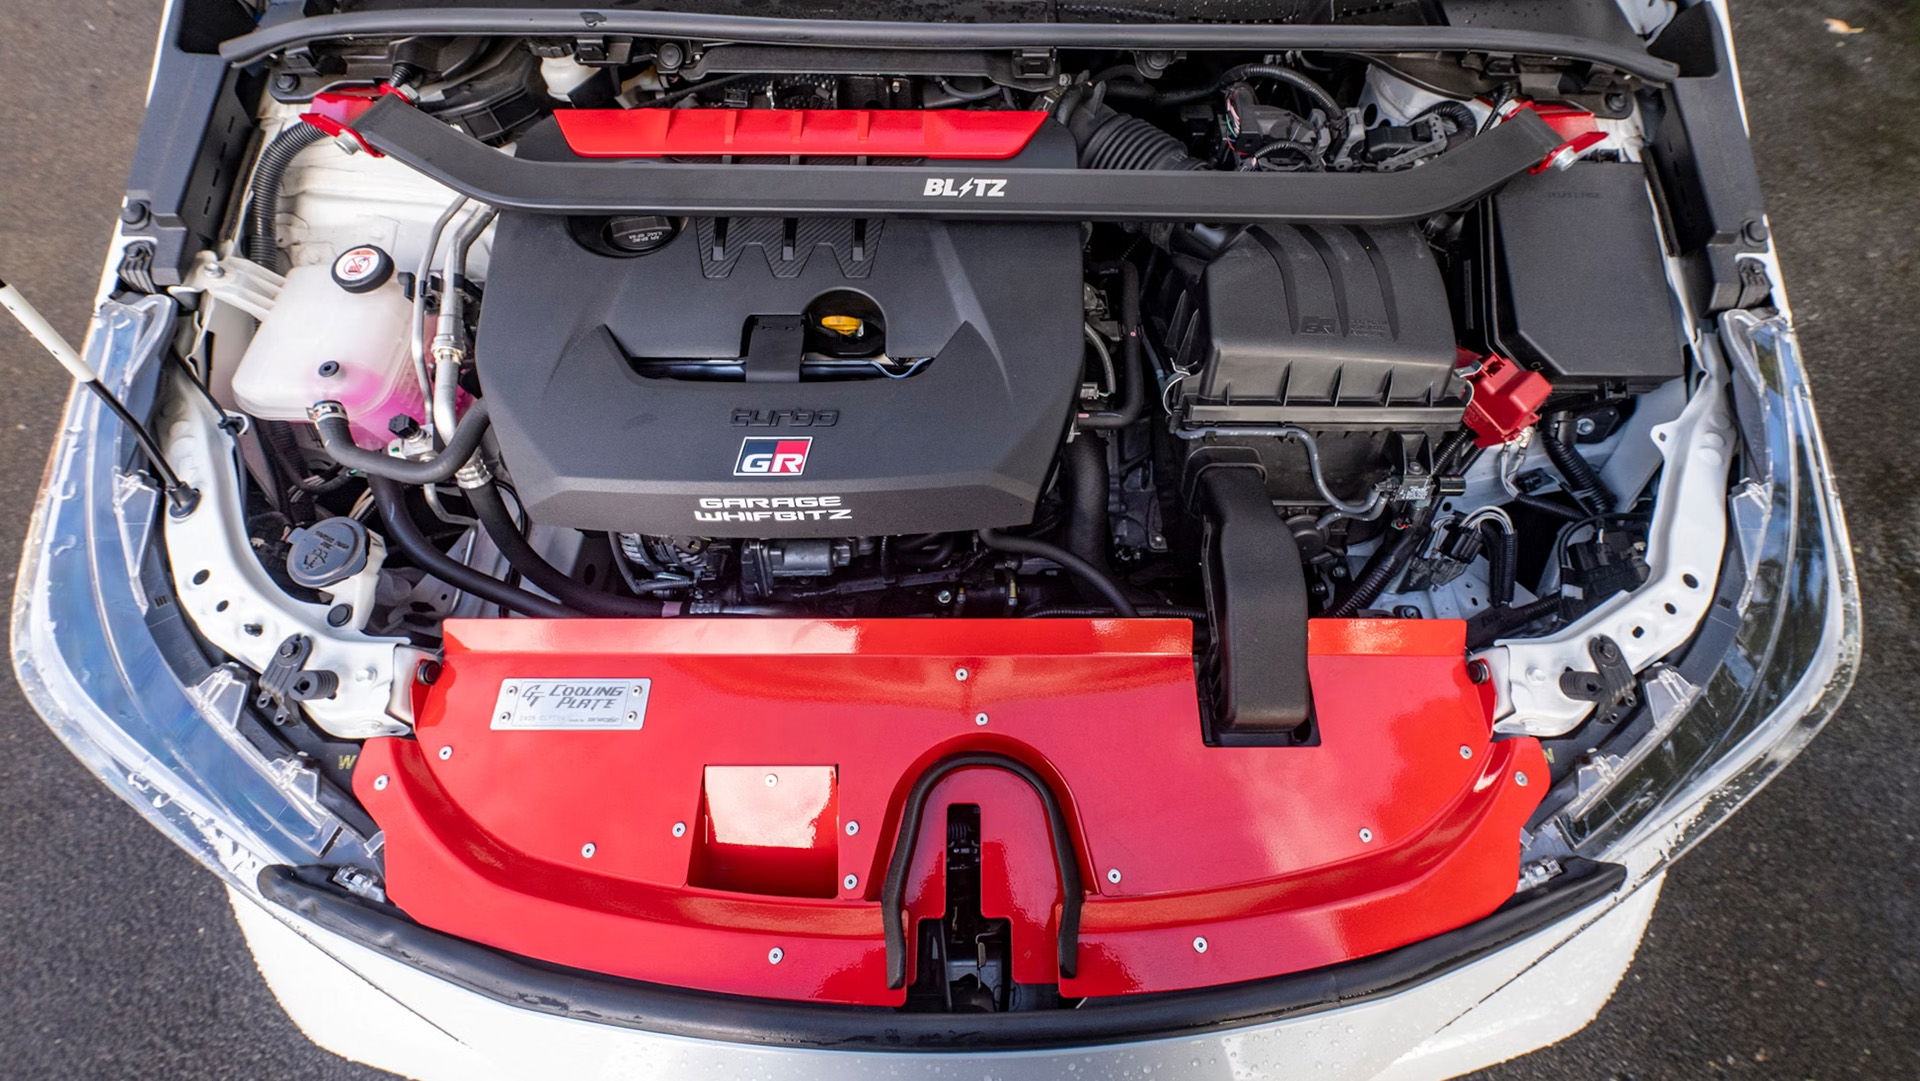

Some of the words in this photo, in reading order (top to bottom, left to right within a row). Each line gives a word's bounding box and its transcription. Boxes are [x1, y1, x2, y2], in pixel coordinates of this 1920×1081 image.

[741, 453, 804, 473] GR
[699, 496, 842, 509] GARAGE
[693, 509, 853, 522] WHIFBITZ
[549, 684, 627, 697] COOLING
[556, 697, 617, 710] PLATE
